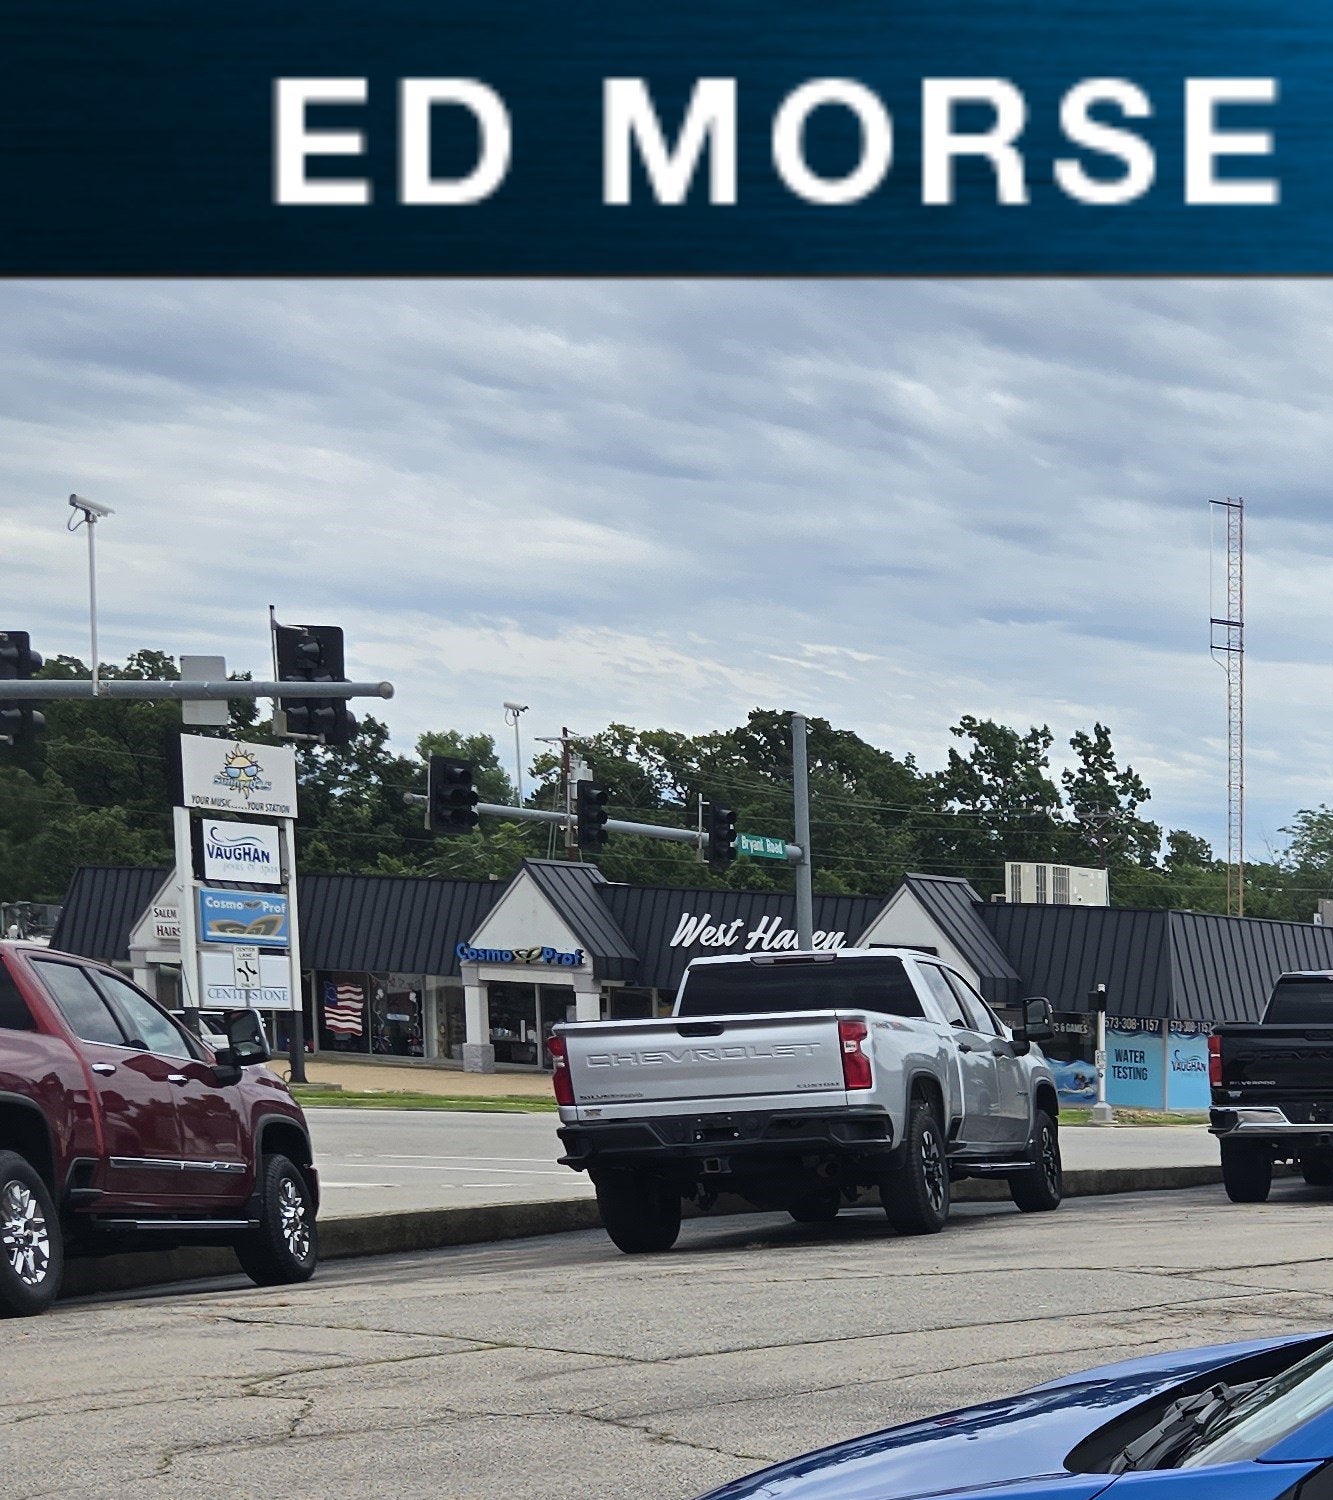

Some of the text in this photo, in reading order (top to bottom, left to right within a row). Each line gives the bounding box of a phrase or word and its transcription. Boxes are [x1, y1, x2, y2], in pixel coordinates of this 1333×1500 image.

[191, 795, 210, 805] YOUR
[205, 843, 270, 863] VAUGHAN
[740, 835, 783, 855] Bryant Road
[153, 907, 177, 919] SALEM
[205, 896, 286, 914] Cosmo Prof
[670, 912, 847, 951] West Haen
[456, 942, 584, 967] Cosmo Prof
[1066, 1024, 1089, 1034] GAMES
[586, 1042, 822, 1070] CHEVROLET
[1114, 1049, 1145, 1064] WATER
[1112, 1065, 1148, 1081] TESTING
[1171, 1060, 1206, 1073] VAUGHAN
